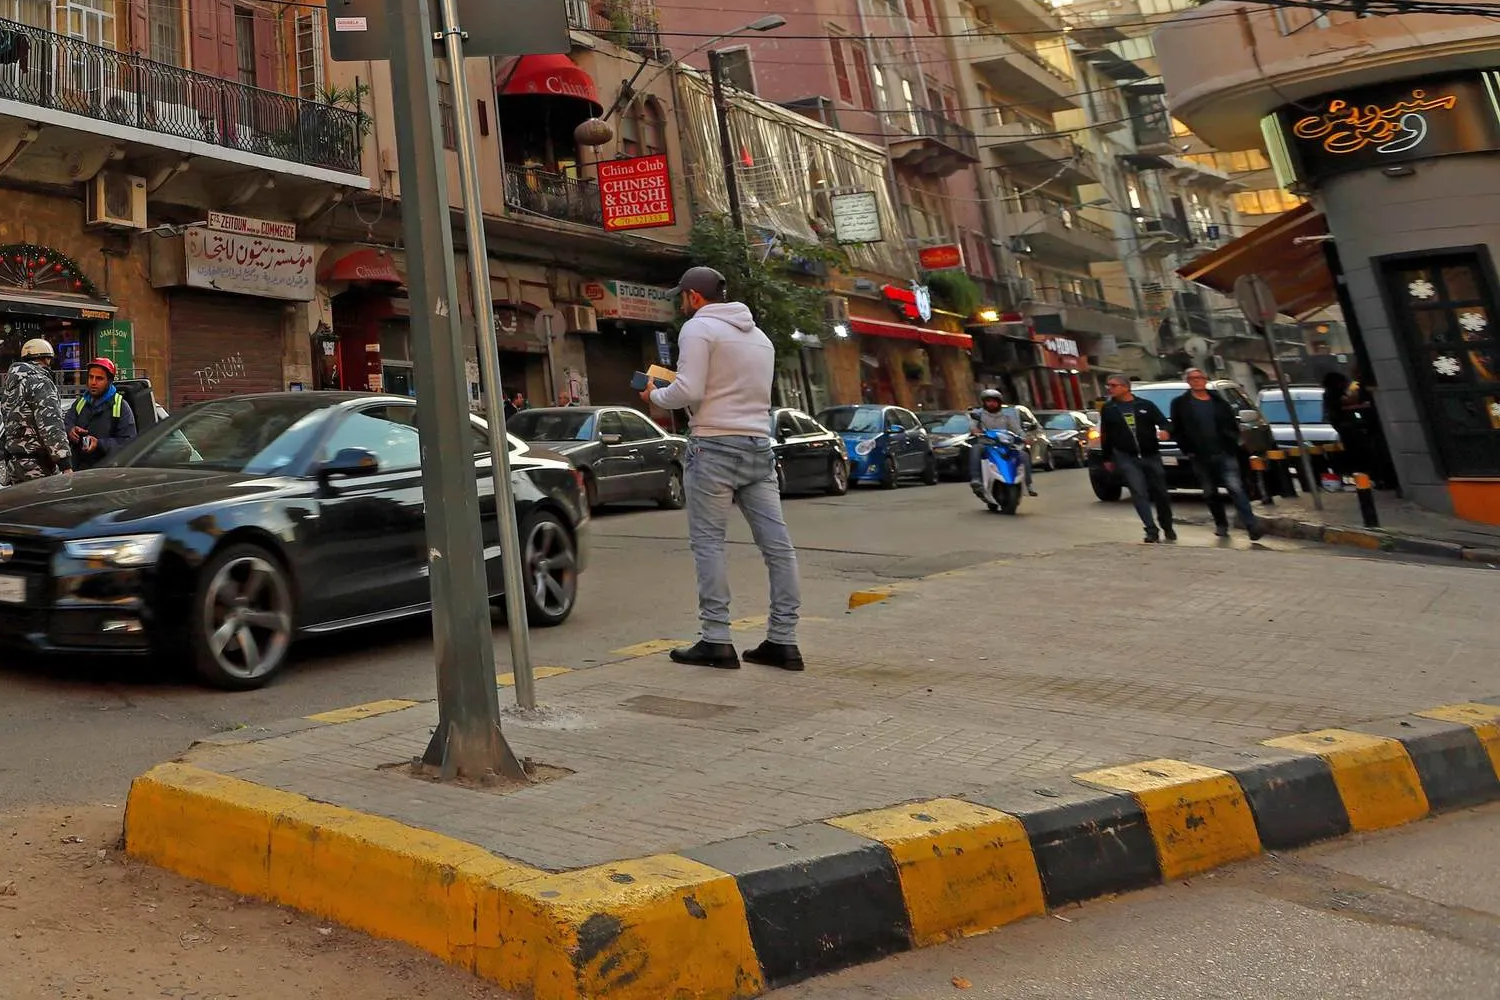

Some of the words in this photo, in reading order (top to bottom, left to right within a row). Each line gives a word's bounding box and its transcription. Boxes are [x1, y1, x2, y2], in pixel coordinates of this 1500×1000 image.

[602, 163, 634, 177] China
[637, 160, 664, 174] Club
[603, 176, 666, 193] CHINESE
[605, 194, 616, 206] &
[619, 187, 668, 204] SUSHI
[606, 201, 669, 217] TERRACE
[221, 214, 247, 232] ZEITOUN
[261, 222, 295, 239] COMMERCE
[189, 231, 235, 262] للتجارة
[620, 284, 645, 298] STUDIO
[99, 329, 128, 339] JAMESON
[193, 352, 246, 392] TRAUM
